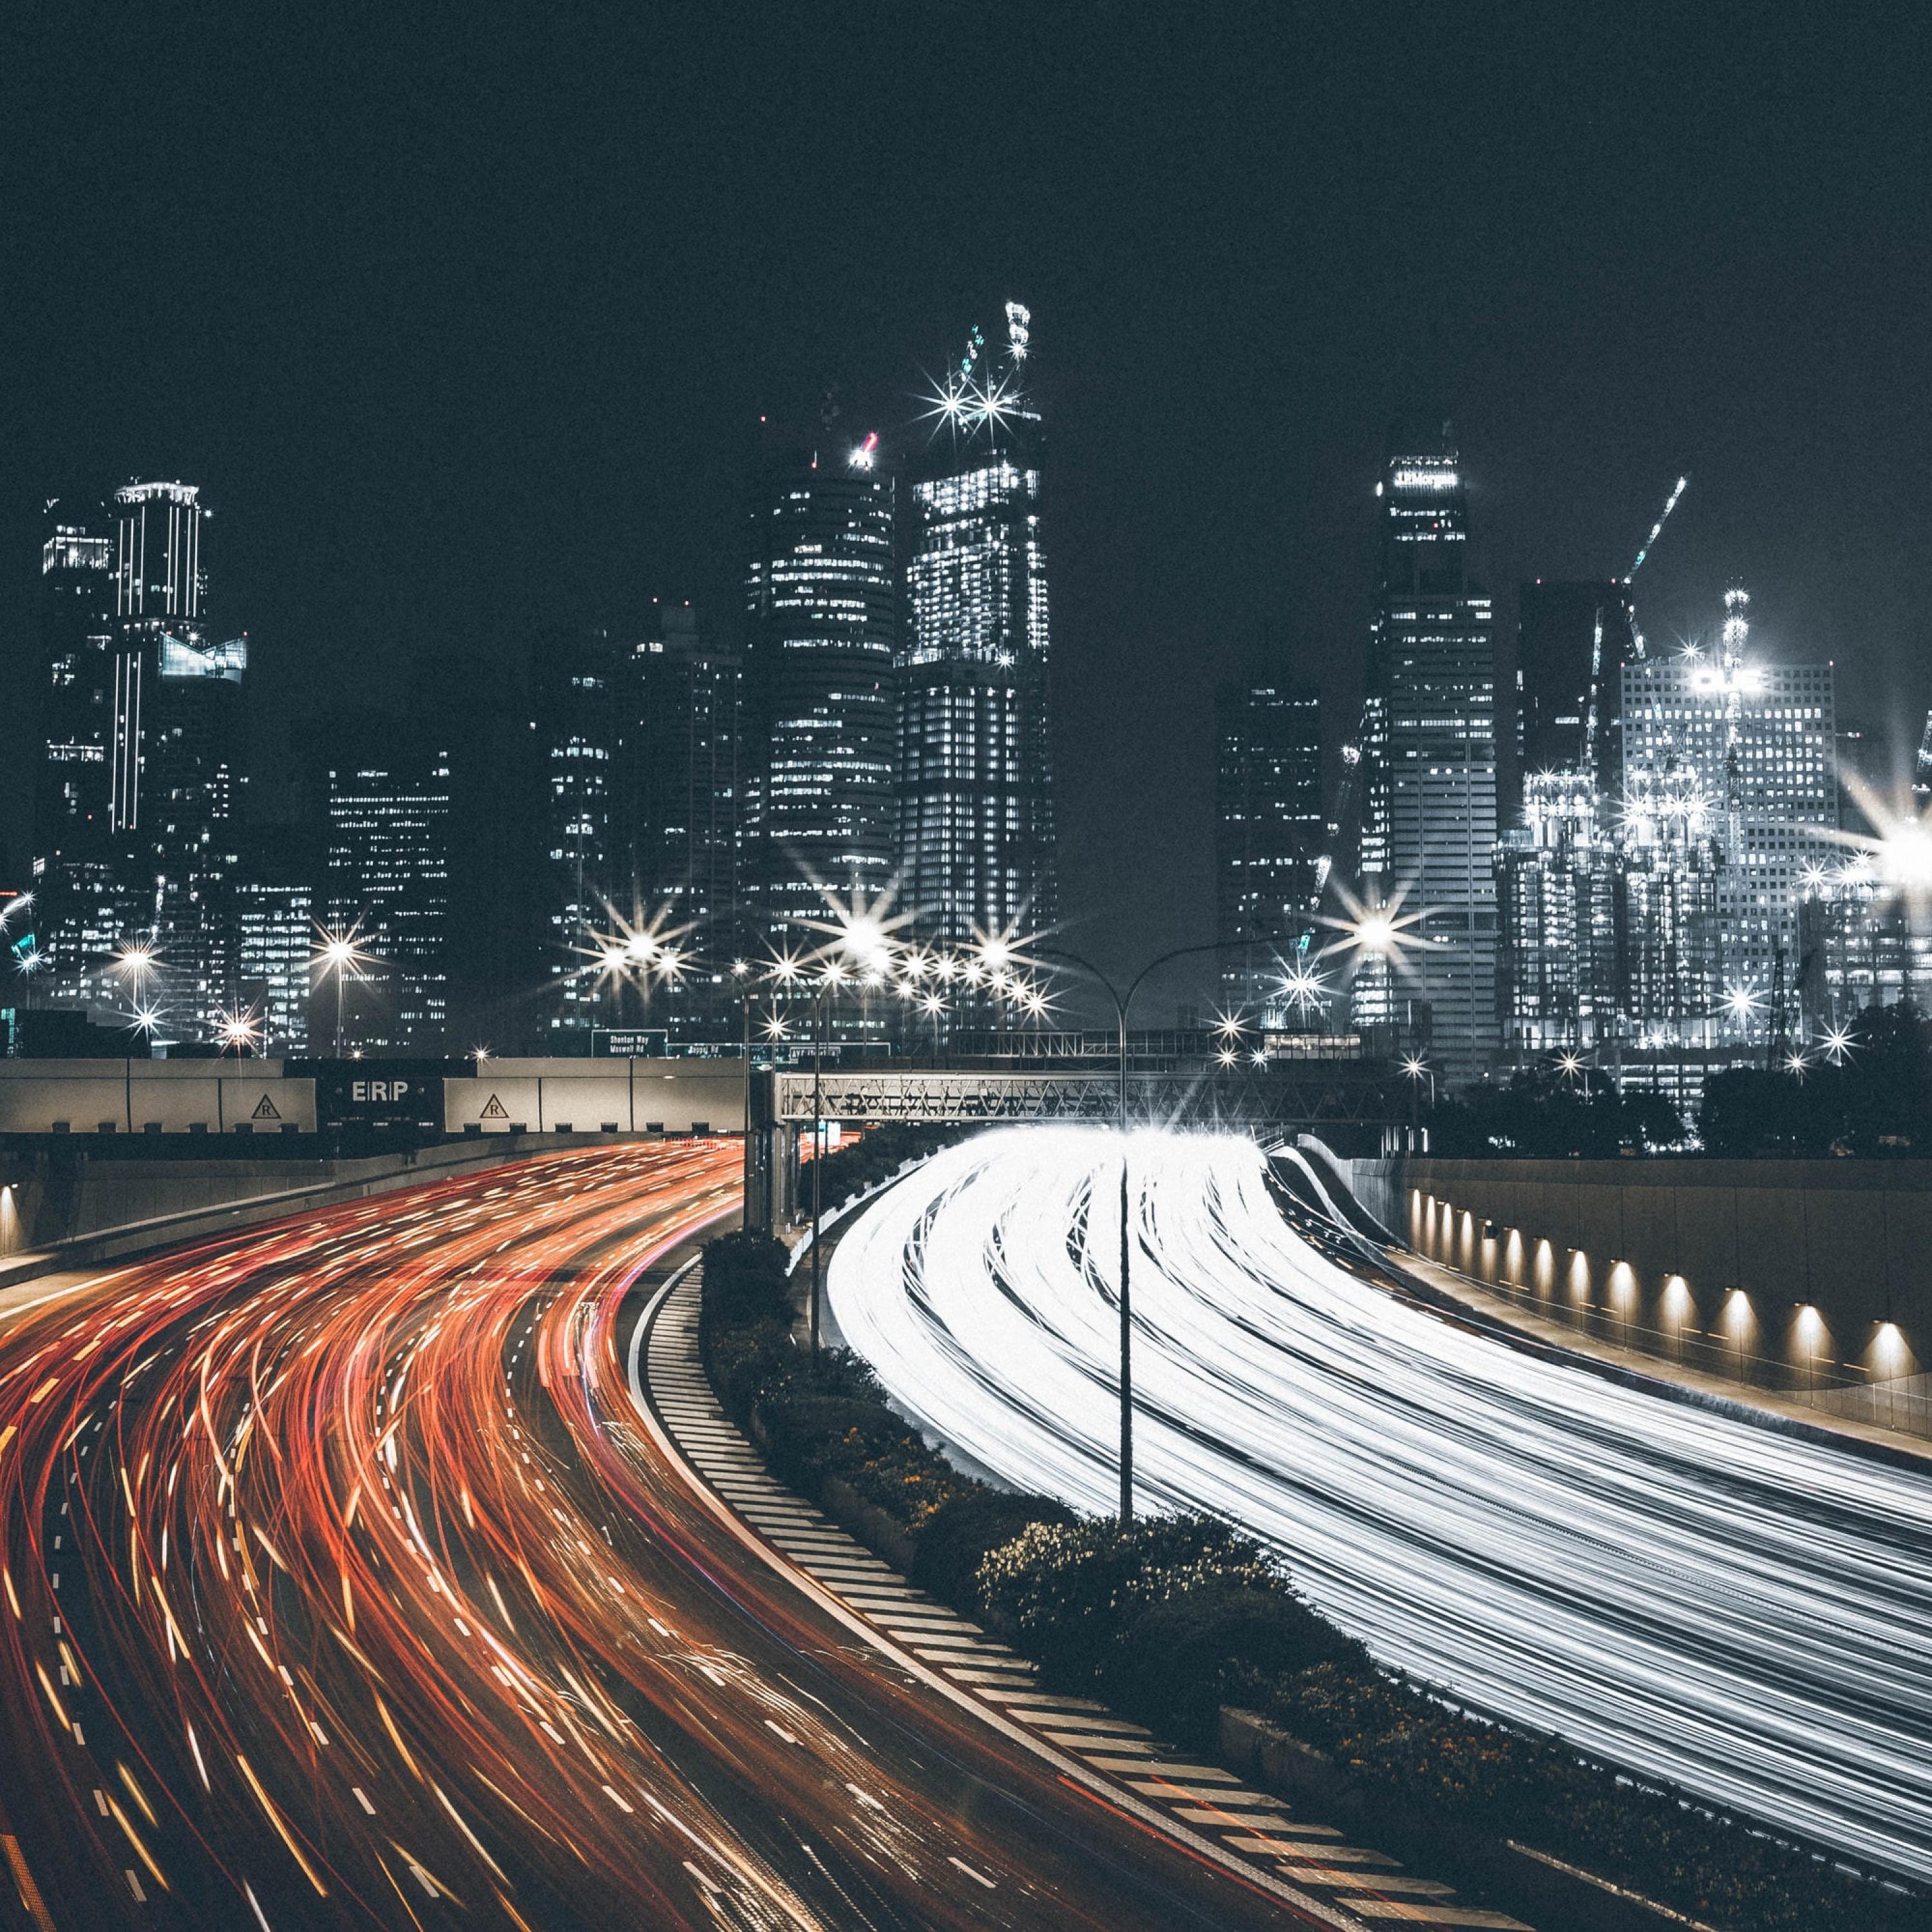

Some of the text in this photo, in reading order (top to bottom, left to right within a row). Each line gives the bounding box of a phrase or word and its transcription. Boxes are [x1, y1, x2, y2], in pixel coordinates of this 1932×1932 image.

[610, 1035, 649, 1045] Shenton Way
[610, 1045, 644, 1053] Maxwell Rd
[262, 1104, 271, 1115] R
[490, 1104, 499, 1115] R
